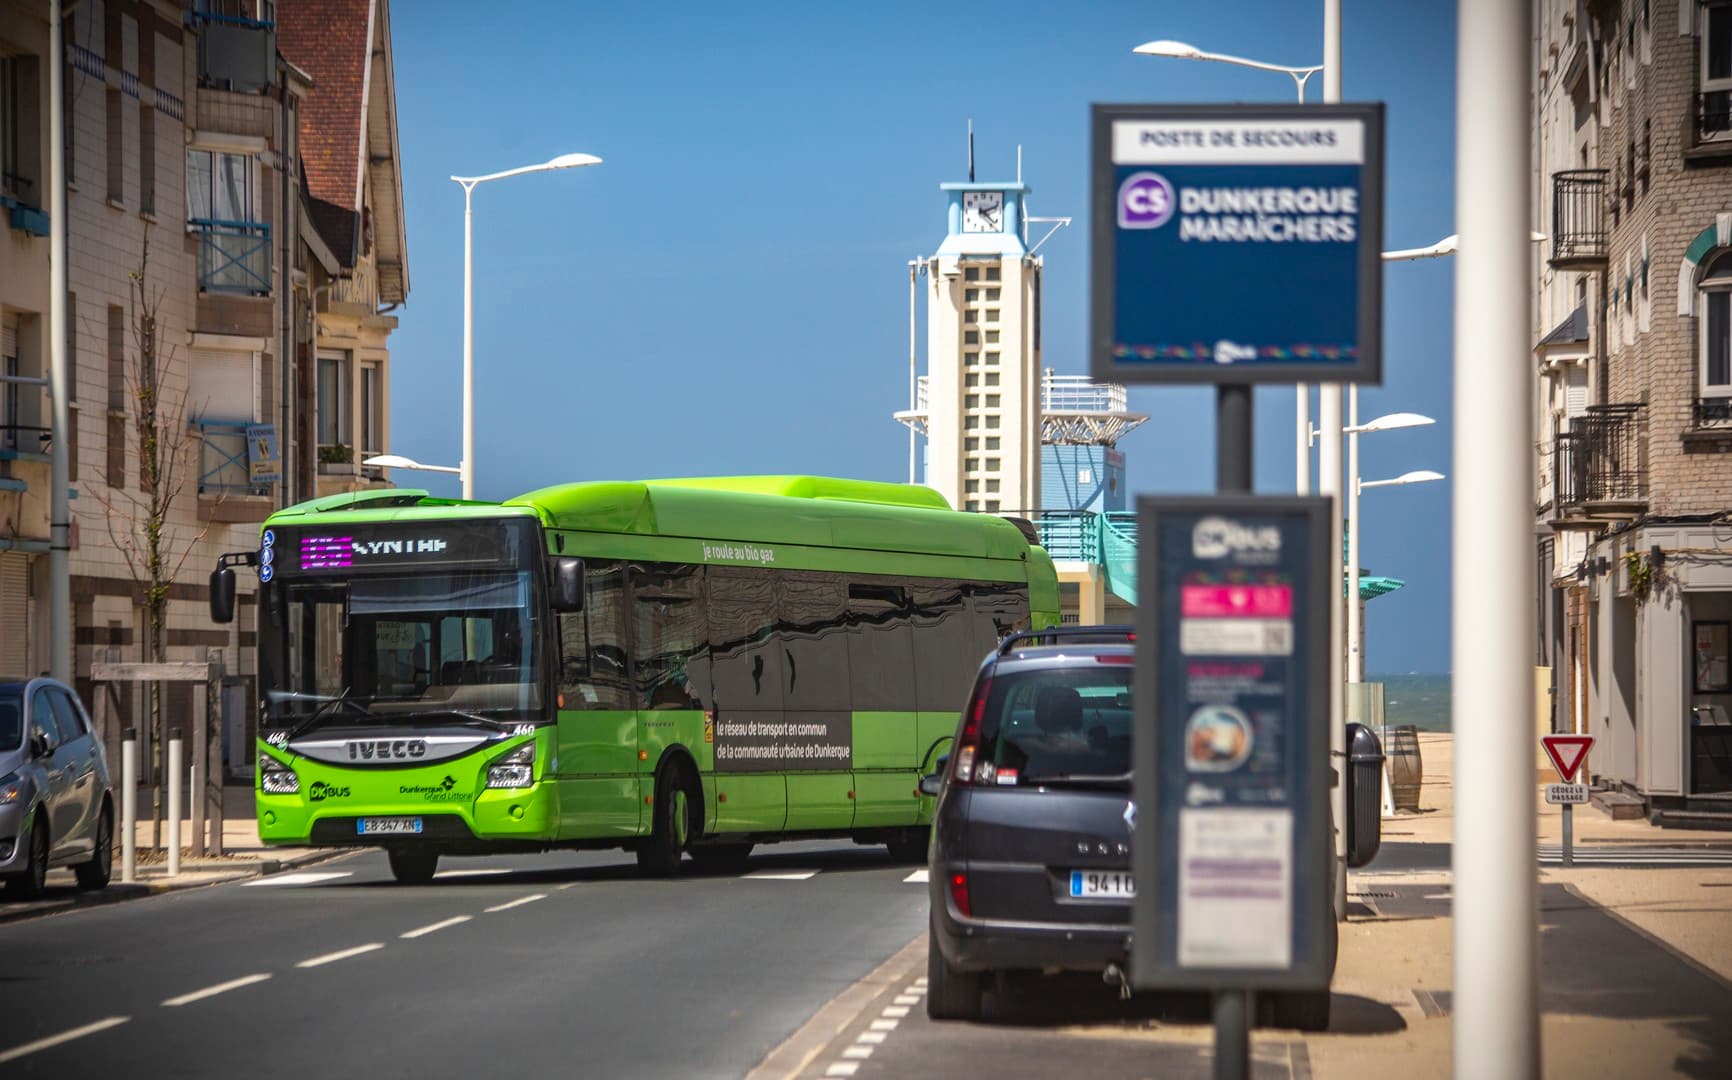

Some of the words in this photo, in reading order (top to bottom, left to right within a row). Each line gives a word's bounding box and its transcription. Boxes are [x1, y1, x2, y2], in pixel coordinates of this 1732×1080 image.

[1140, 129, 1204, 147] POSTE
[1210, 129, 1238, 147] DE
[1242, 129, 1337, 147] SECOURS
[1179, 187, 1358, 213] DUNKERQUE
[702, 542, 712, 561] je
[712, 544, 733, 559] route
[734, 547, 744, 560] au
[745, 545, 759, 560] bio
[760, 549, 775, 564] gaz
[725, 720, 748, 736] réseau
[748, 721, 757, 736] de
[757, 722, 788, 739] transport
[789, 725, 798, 736] en
[798, 724, 827, 737] commun
[349, 740, 427, 760] IVECO
[717, 744, 726, 759] de
[727, 744, 734, 759] la
[734, 742, 778, 759] communauté
[779, 744, 804, 759] urbaine
[805, 743, 814, 759] de
[814, 743, 850, 760] Dunkerque
[400, 785, 443, 796] Dunkerque
[424, 792, 447, 800] Grand
[448, 792, 473, 800] Littoral
